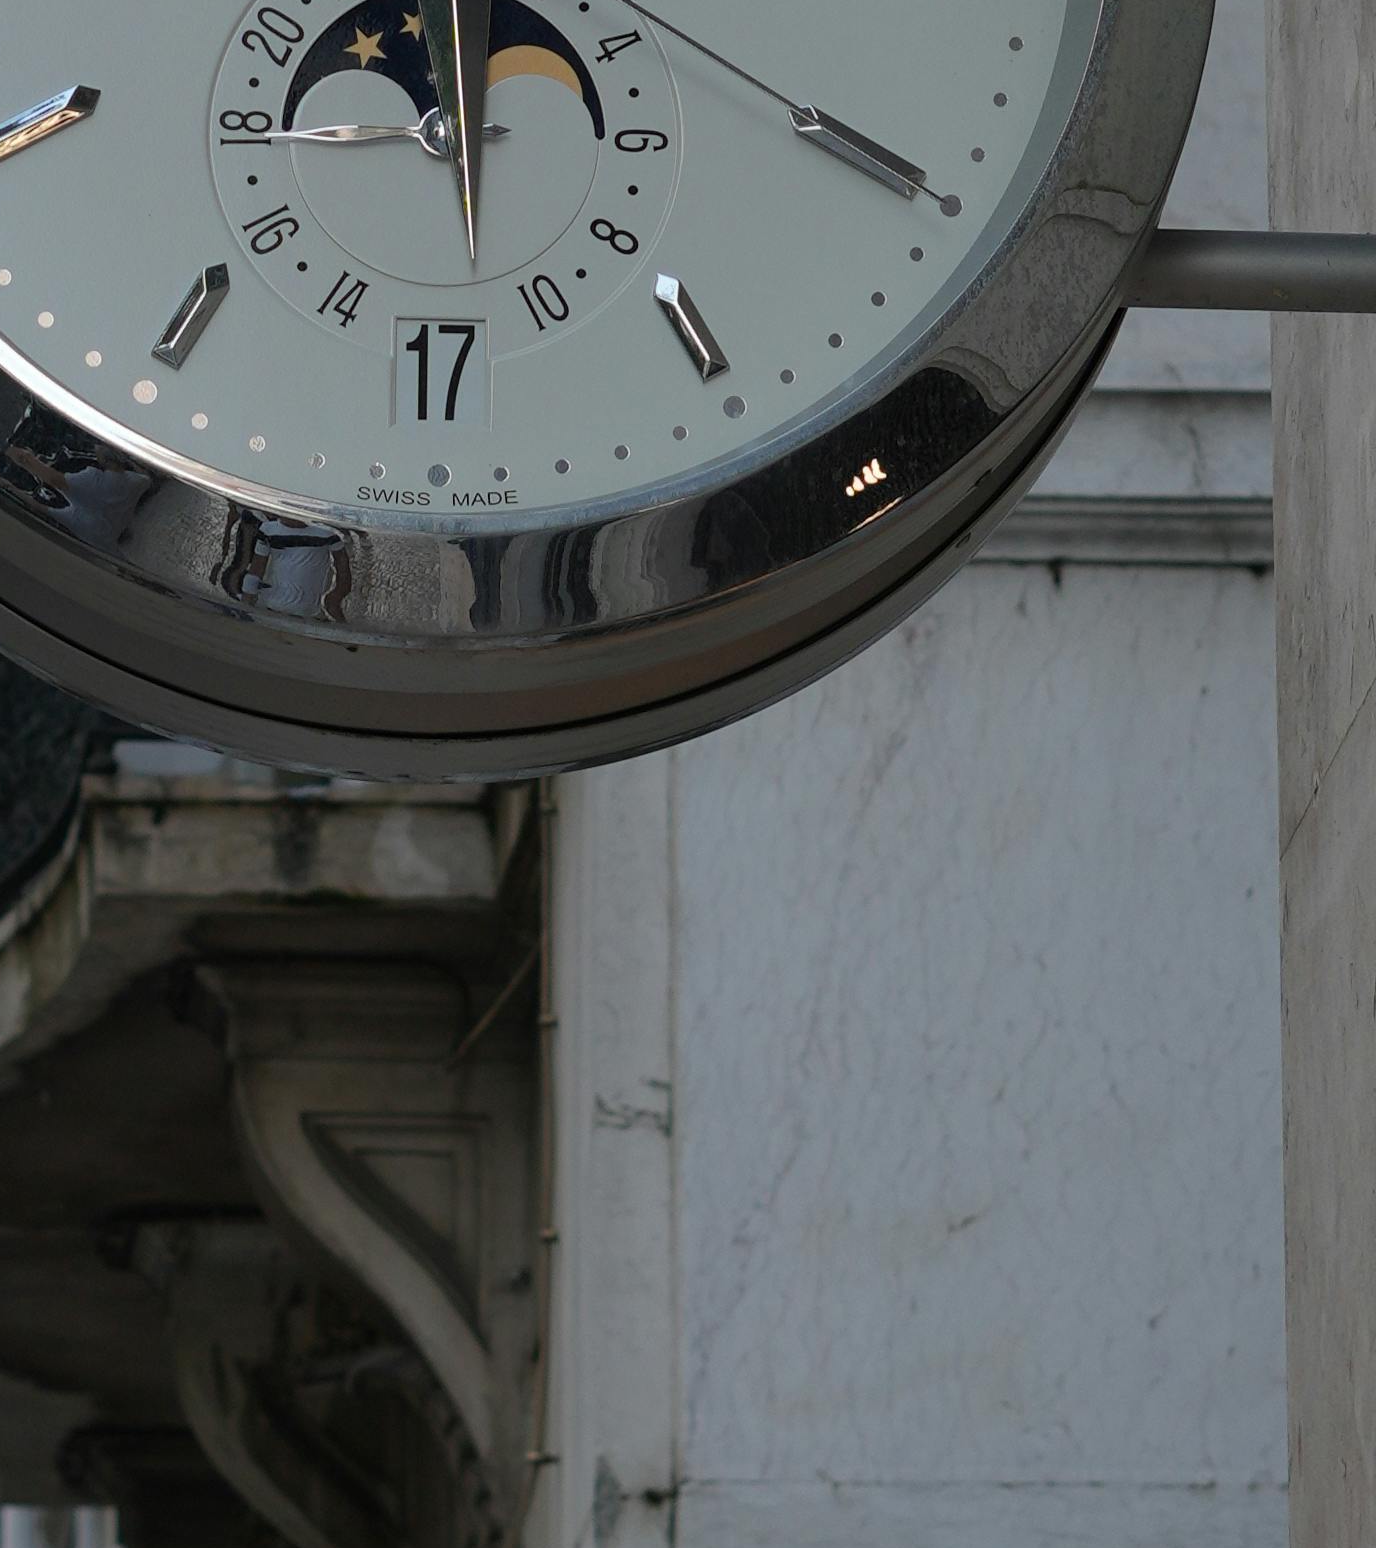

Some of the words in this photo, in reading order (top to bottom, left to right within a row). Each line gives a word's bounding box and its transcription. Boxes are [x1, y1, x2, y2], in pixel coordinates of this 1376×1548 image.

[241, 6, 305, 69] 20
[594, 29, 642, 64] 4
[219, 109, 273, 147] 18
[241, 203, 300, 256] 16
[589, 218, 640, 256] 8
[316, 270, 370, 329] 14
[516, 274, 570, 332] 10
[406, 324, 475, 421] 17
[356, 486, 431, 506] SWISS
[451, 489, 519, 507] MADE
